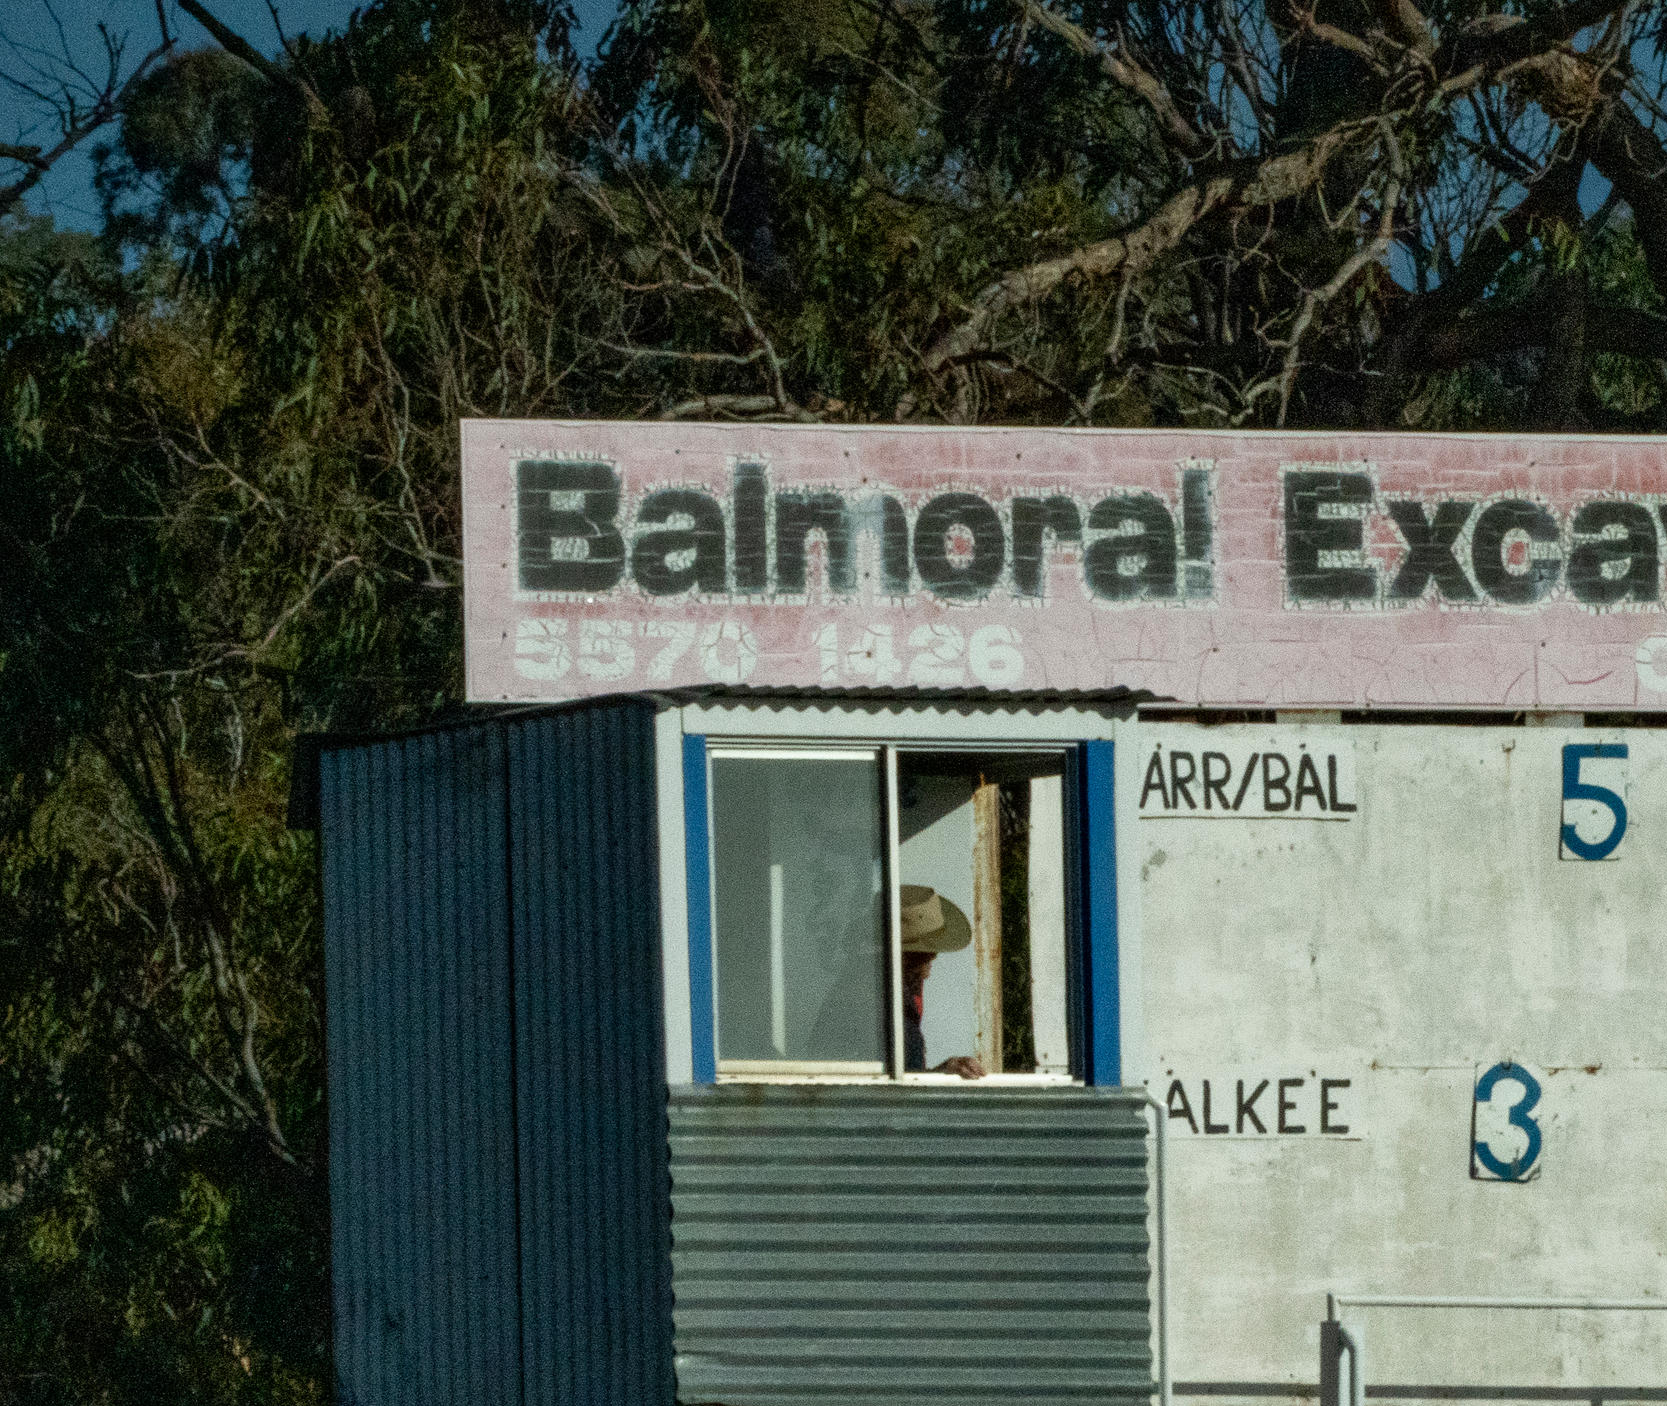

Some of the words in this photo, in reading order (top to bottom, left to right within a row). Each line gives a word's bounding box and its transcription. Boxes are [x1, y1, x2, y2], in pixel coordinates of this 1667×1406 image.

[511, 453, 1217, 602] Balmoral
[514, 617, 757, 682] 5570
[811, 622, 1026, 688] 1426
[1139, 750, 1357, 813] ARR/BAL
[1562, 744, 1628, 861] 5
[1475, 1061, 1542, 1181] 3
